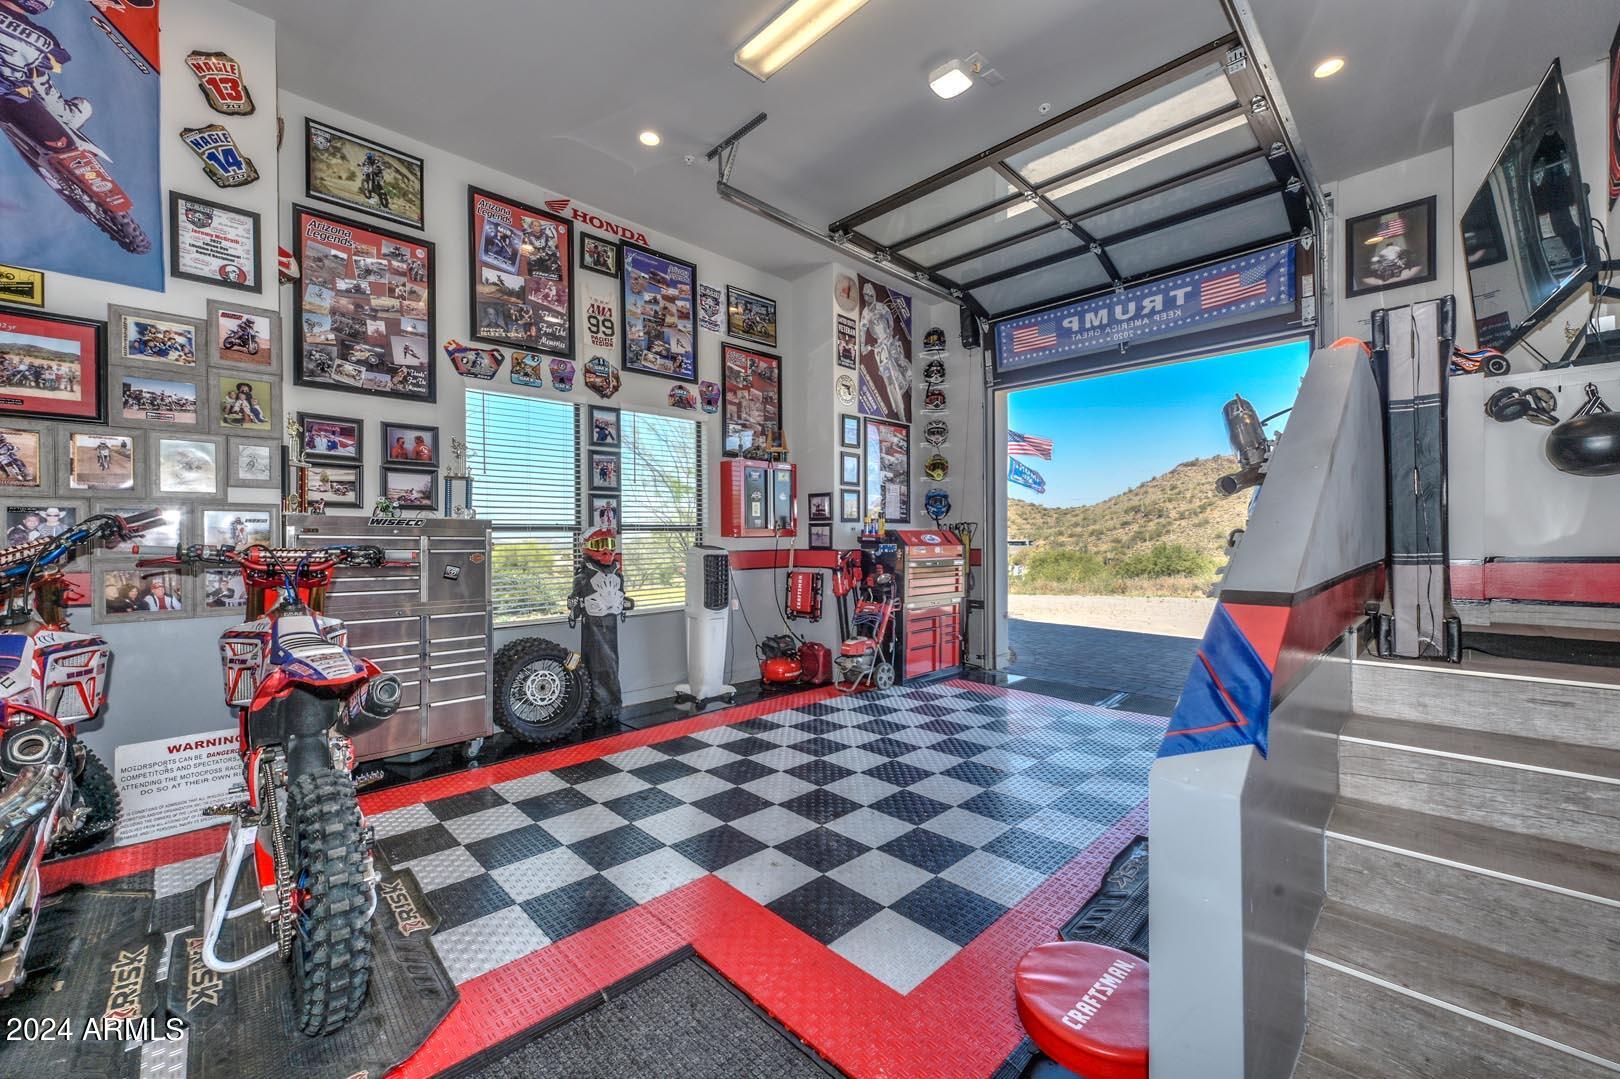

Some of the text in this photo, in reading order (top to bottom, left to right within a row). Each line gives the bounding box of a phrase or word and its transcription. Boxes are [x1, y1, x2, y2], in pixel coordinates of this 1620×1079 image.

[191, 60, 238, 76] NAGLE
[205, 76, 243, 102] 13
[189, 131, 232, 152] NAGLE
[205, 147, 243, 175] 14
[477, 206, 513, 224] Legends
[478, 198, 512, 216] Arizona
[307, 219, 352, 238] Arizona
[571, 207, 650, 247] HONDA
[305, 228, 353, 247] Legends
[587, 303, 613, 318] AMA
[587, 314, 615, 338] 99
[370, 518, 426, 527] WISECO
[120, 758, 177, 774] MOTORSPORTS
[178, 755, 193, 765] CAN
[206, 747, 240, 759] DANGERO
[120, 768, 175, 783] COMPETITORS
[176, 764, 192, 773] AND
[120, 779, 163, 792] ATTENDING
[164, 776, 178, 784] THE
[140, 788, 154, 796] DO
[156, 786, 169, 794] SO
[170, 783, 181, 791] AT
[184, 777, 209, 788] THEIR
[211, 773, 231, 783] OWN
[1062, 959, 1133, 1030] CRAFTSMAN
